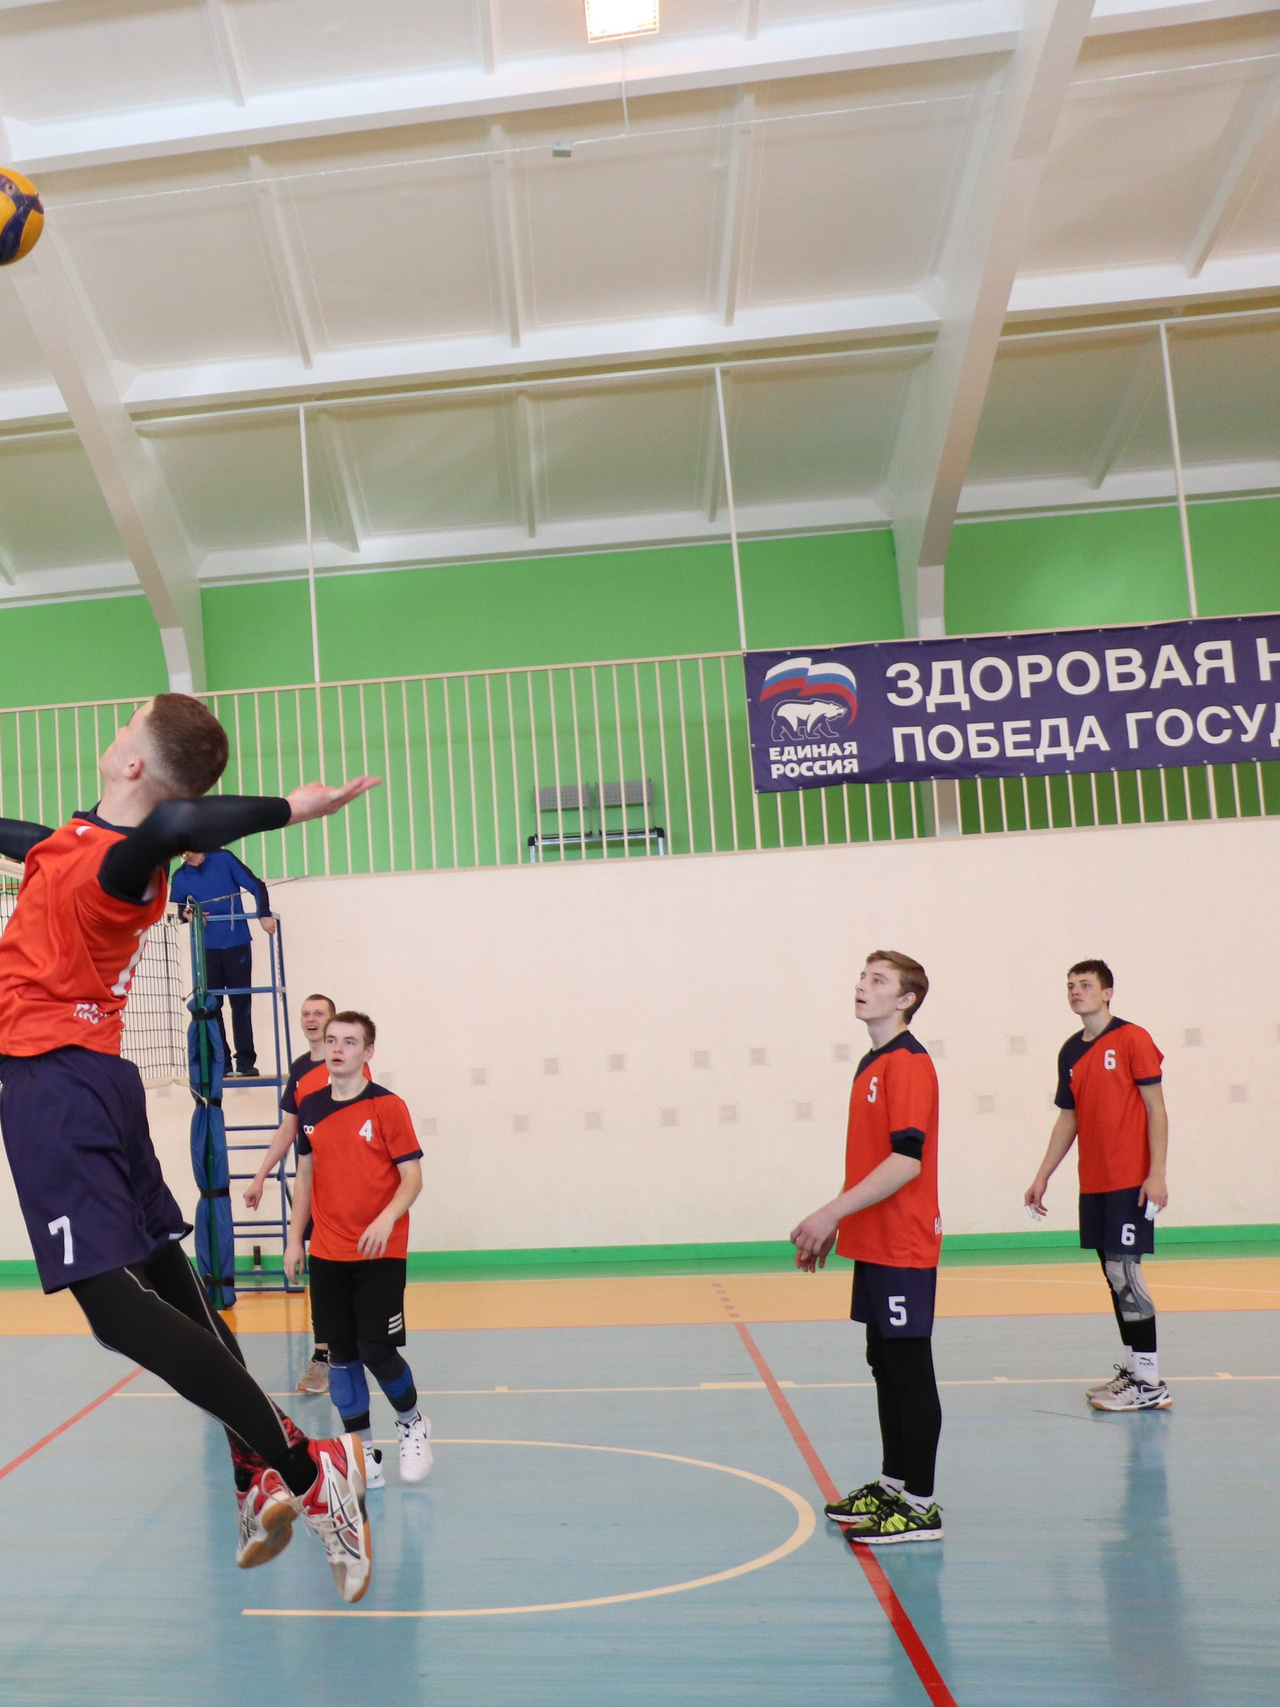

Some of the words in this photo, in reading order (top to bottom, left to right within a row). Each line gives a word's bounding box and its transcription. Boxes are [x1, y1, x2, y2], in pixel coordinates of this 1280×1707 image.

[885, 640, 1236, 713] ЗДОРОВАЯ
[769, 741, 858, 761] ЕДИНАЯ
[892, 715, 1111, 763] ПОБЕДА
[771, 758, 859, 779] РОССИЯ
[1103, 1049, 1117, 1070] 6
[867, 1076, 878, 1103] 5
[358, 1118, 373, 1142] 4
[47, 1215, 74, 1265] 7
[1120, 1223, 1136, 1246] 6
[888, 1295, 908, 1327] 5
